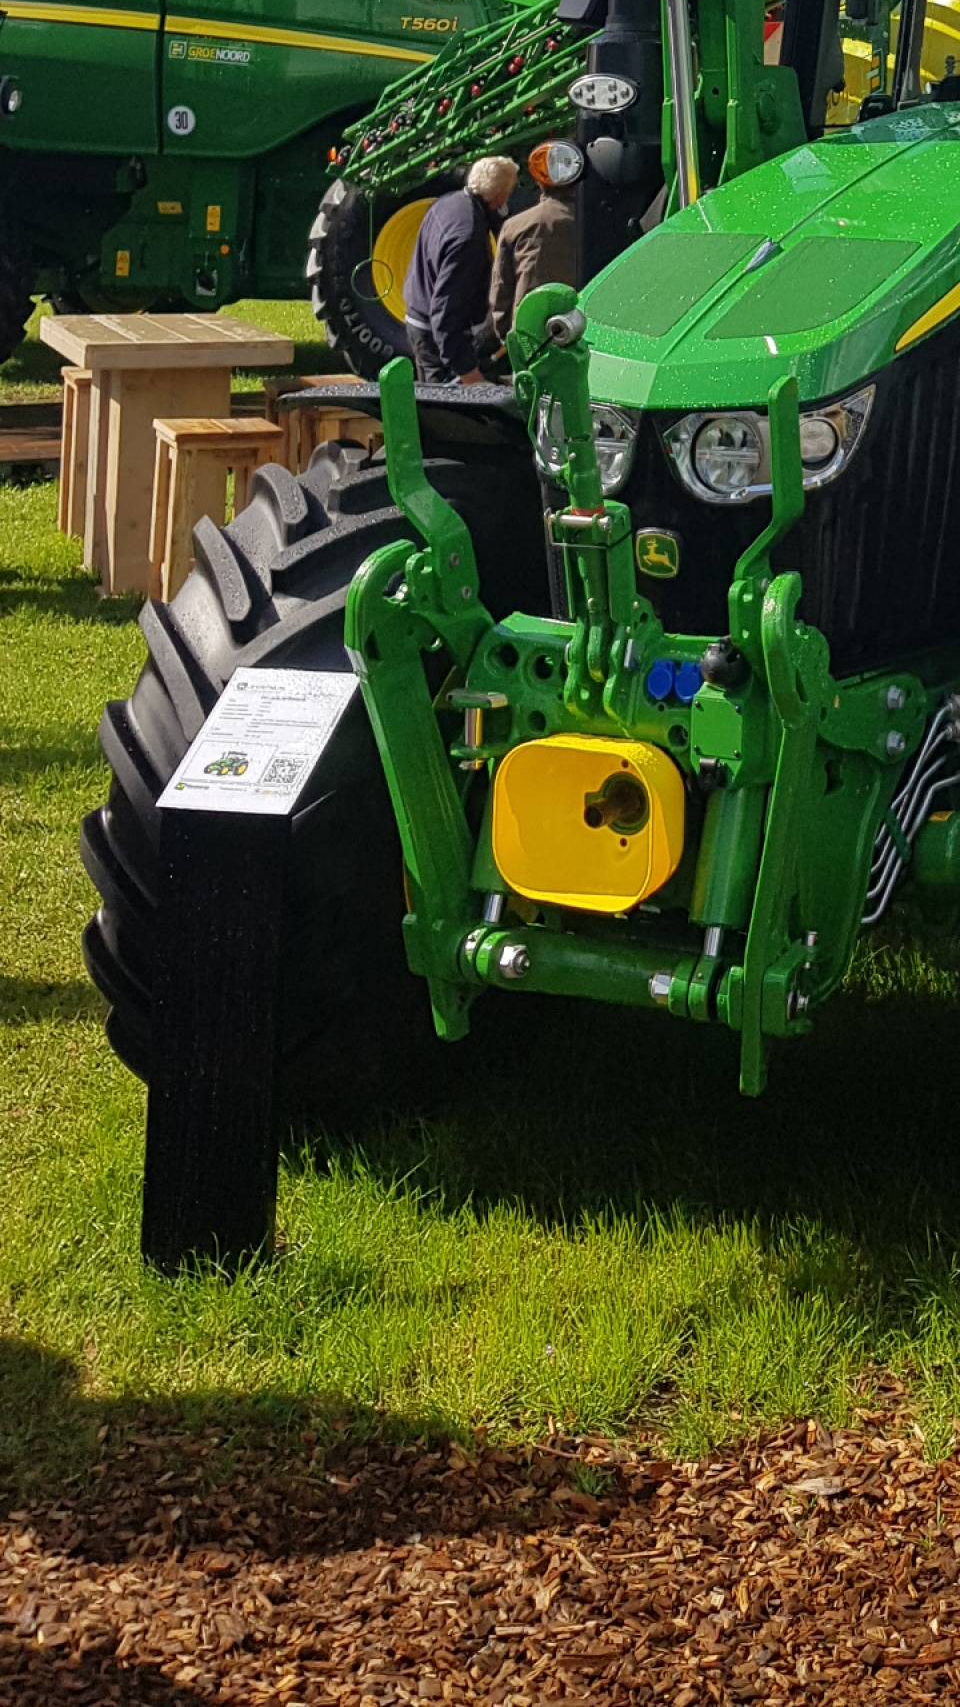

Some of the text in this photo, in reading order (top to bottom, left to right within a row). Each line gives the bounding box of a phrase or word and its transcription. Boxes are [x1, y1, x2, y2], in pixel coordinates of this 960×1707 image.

[400, 16, 458, 32] T560i
[187, 46, 250, 63] GROENOORD
[175, 111, 188, 131] 30
